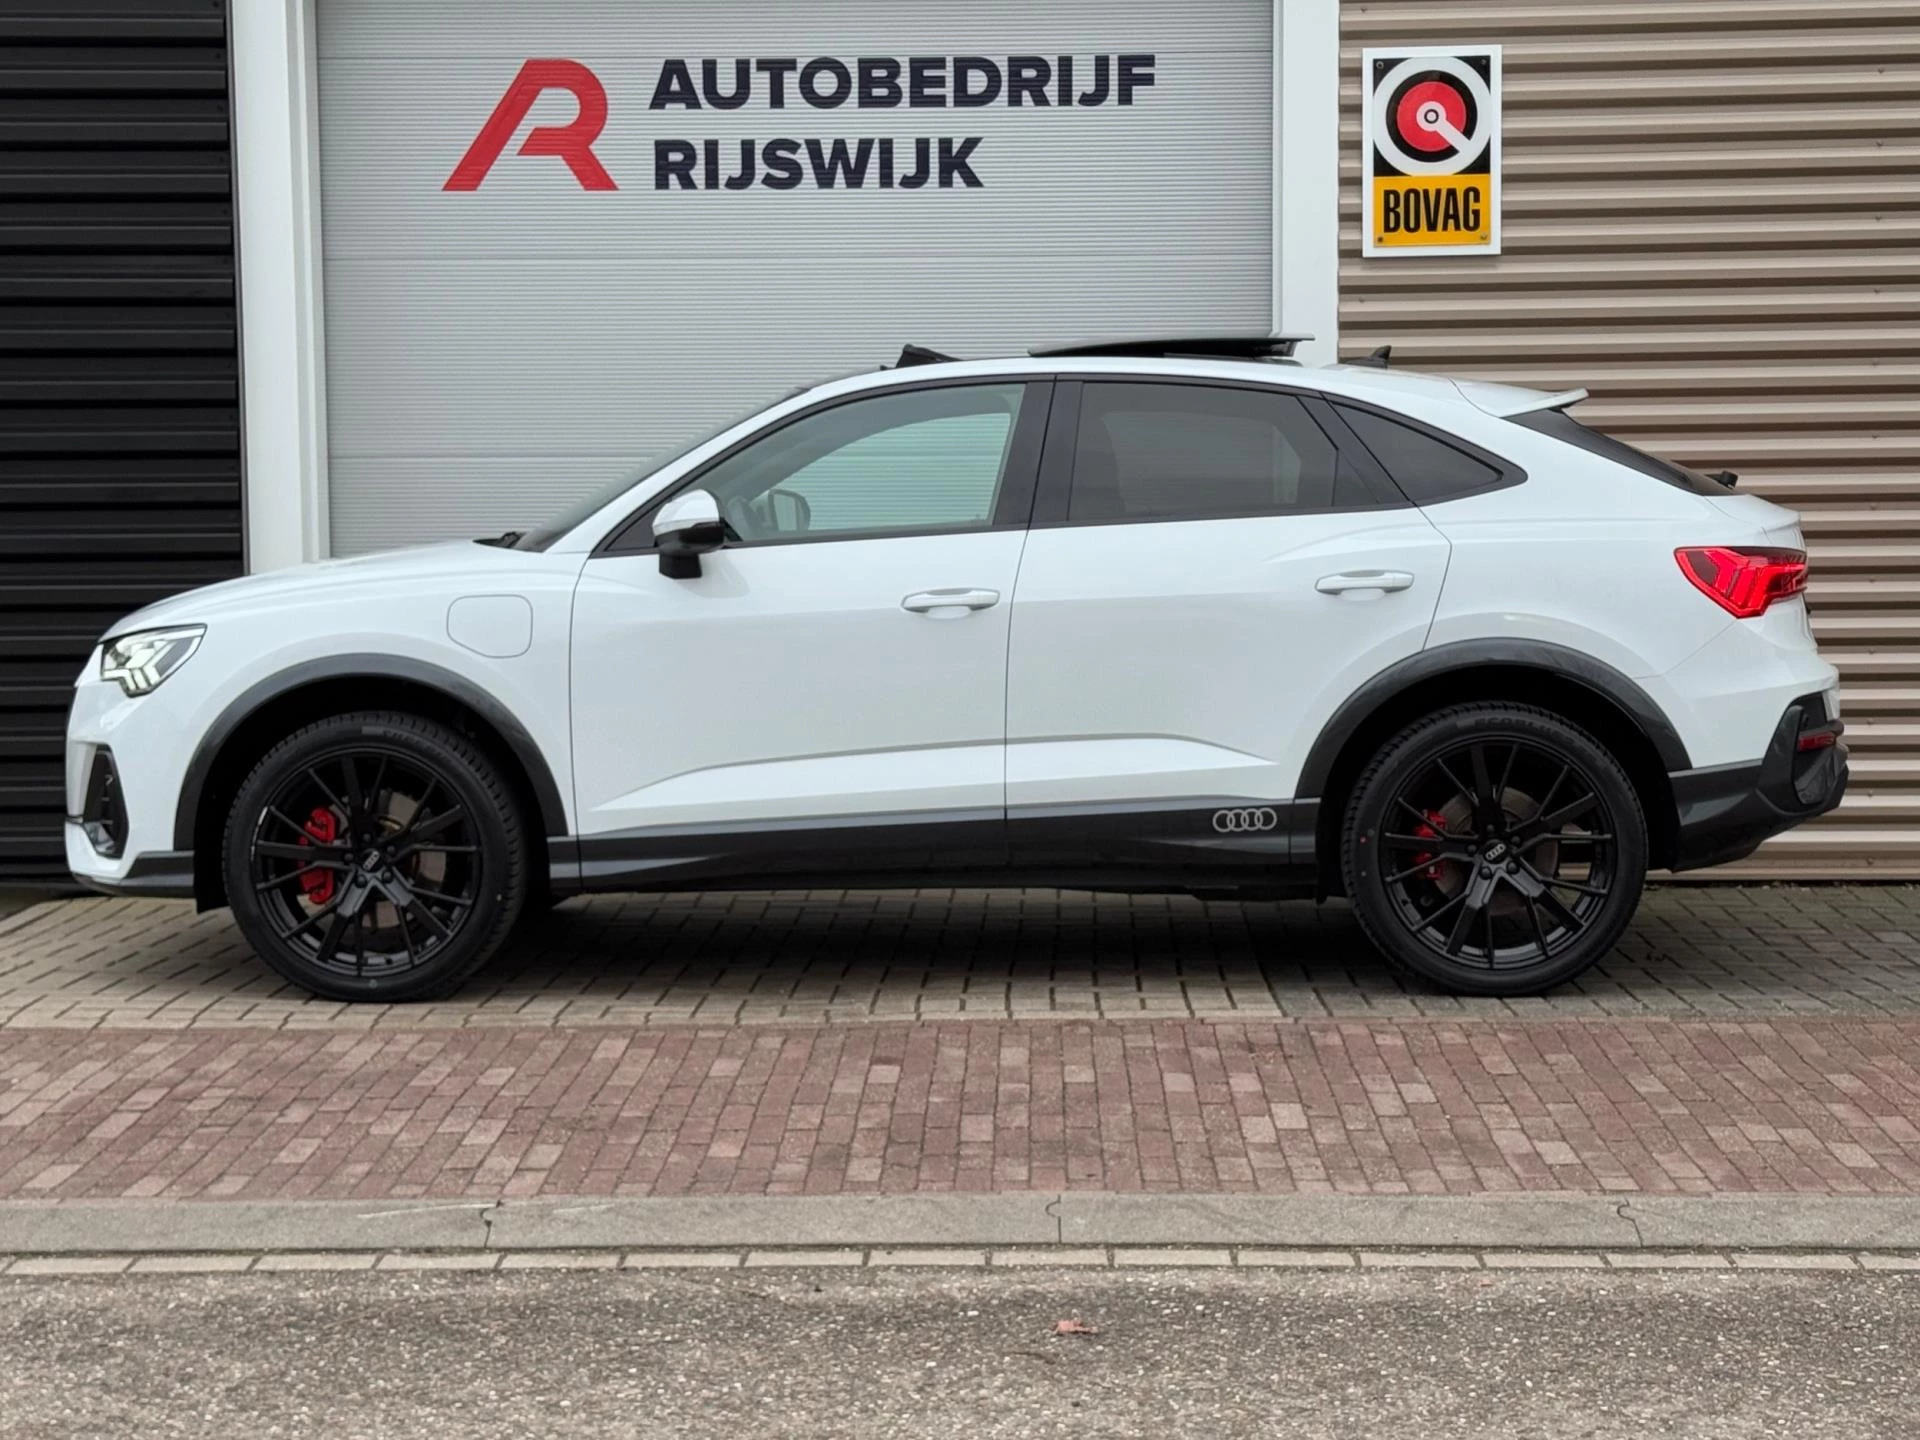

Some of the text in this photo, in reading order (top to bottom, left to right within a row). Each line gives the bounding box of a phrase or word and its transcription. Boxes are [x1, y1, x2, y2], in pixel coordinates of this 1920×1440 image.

[649, 54, 1156, 110] AUTOBEDRIJF
[654, 136, 984, 191] RIJSWIJK
[1383, 186, 1481, 233] BOVAG
